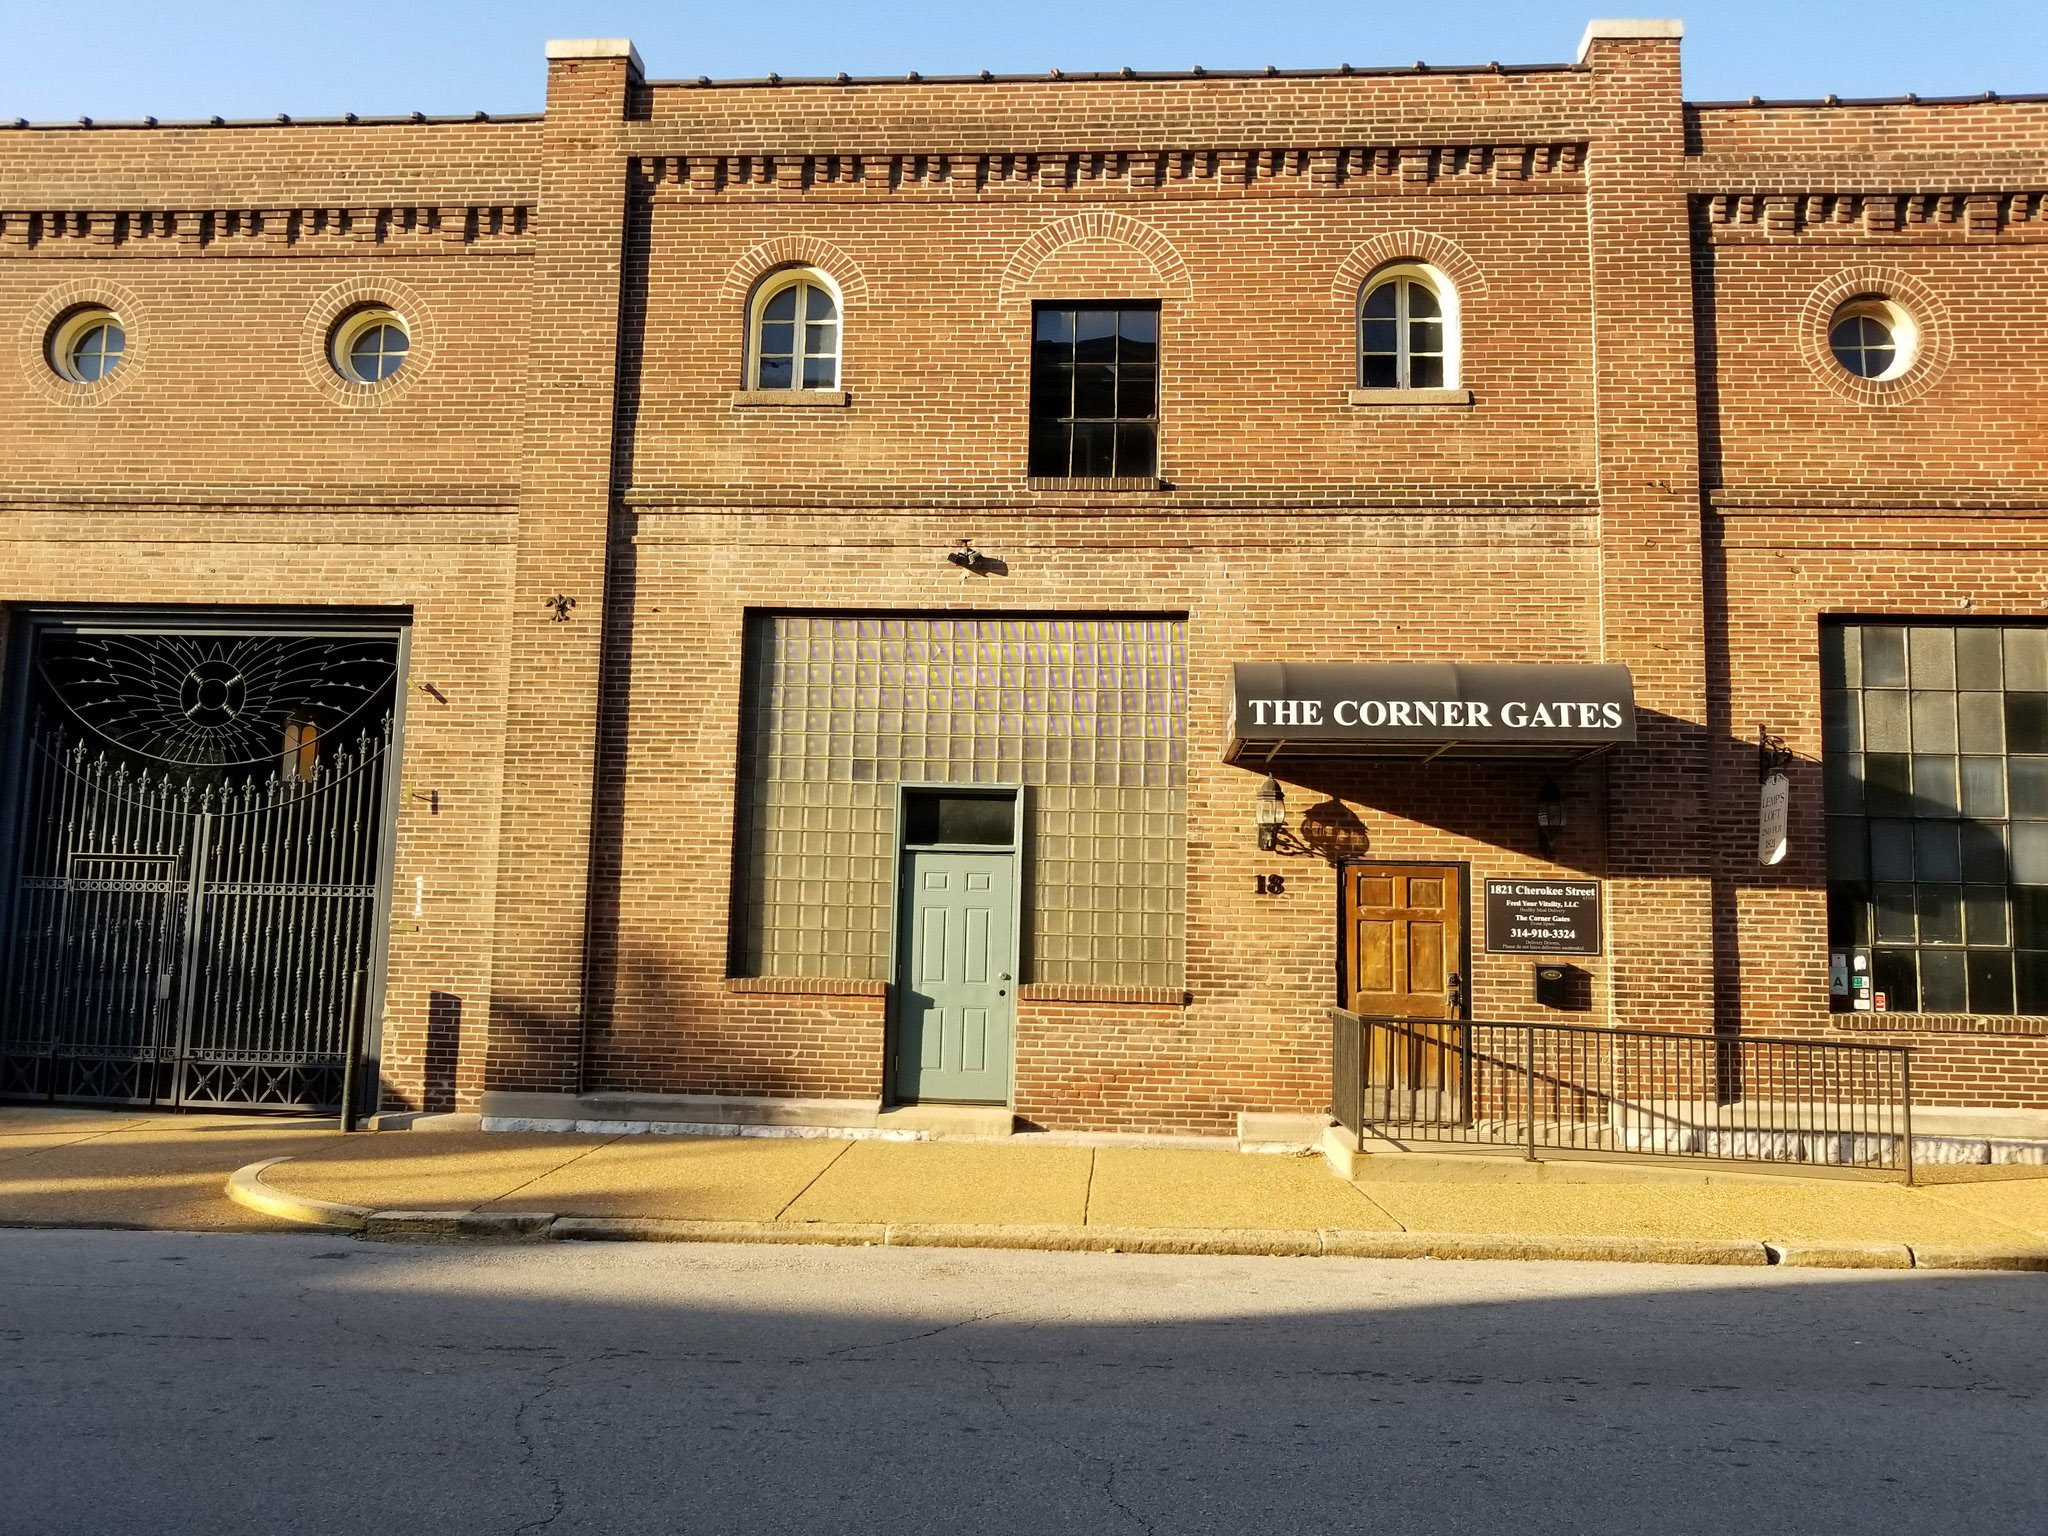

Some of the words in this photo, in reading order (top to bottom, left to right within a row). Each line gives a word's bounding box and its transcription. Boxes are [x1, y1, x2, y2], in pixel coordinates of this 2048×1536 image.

[1248, 699, 1323, 726] THE
[1332, 699, 1493, 728] CORNER
[1500, 701, 1623, 729] GATES
[1762, 792, 1785, 809] LEMP'S
[1764, 809, 1781, 822] LOFT
[1762, 827, 1772, 836] 2ND
[1766, 838, 1776, 848] 1821
[1254, 874, 1285, 894] 18
[1490, 885, 1513, 894] 1821
[1515, 885, 1563, 896] Cherokee
[1565, 887, 1596, 896] Street
[1539, 900, 1563, 909] Vitality,
[1510, 928, 1576, 939] 314-910-3324
[1833, 977, 1844, 986] A
